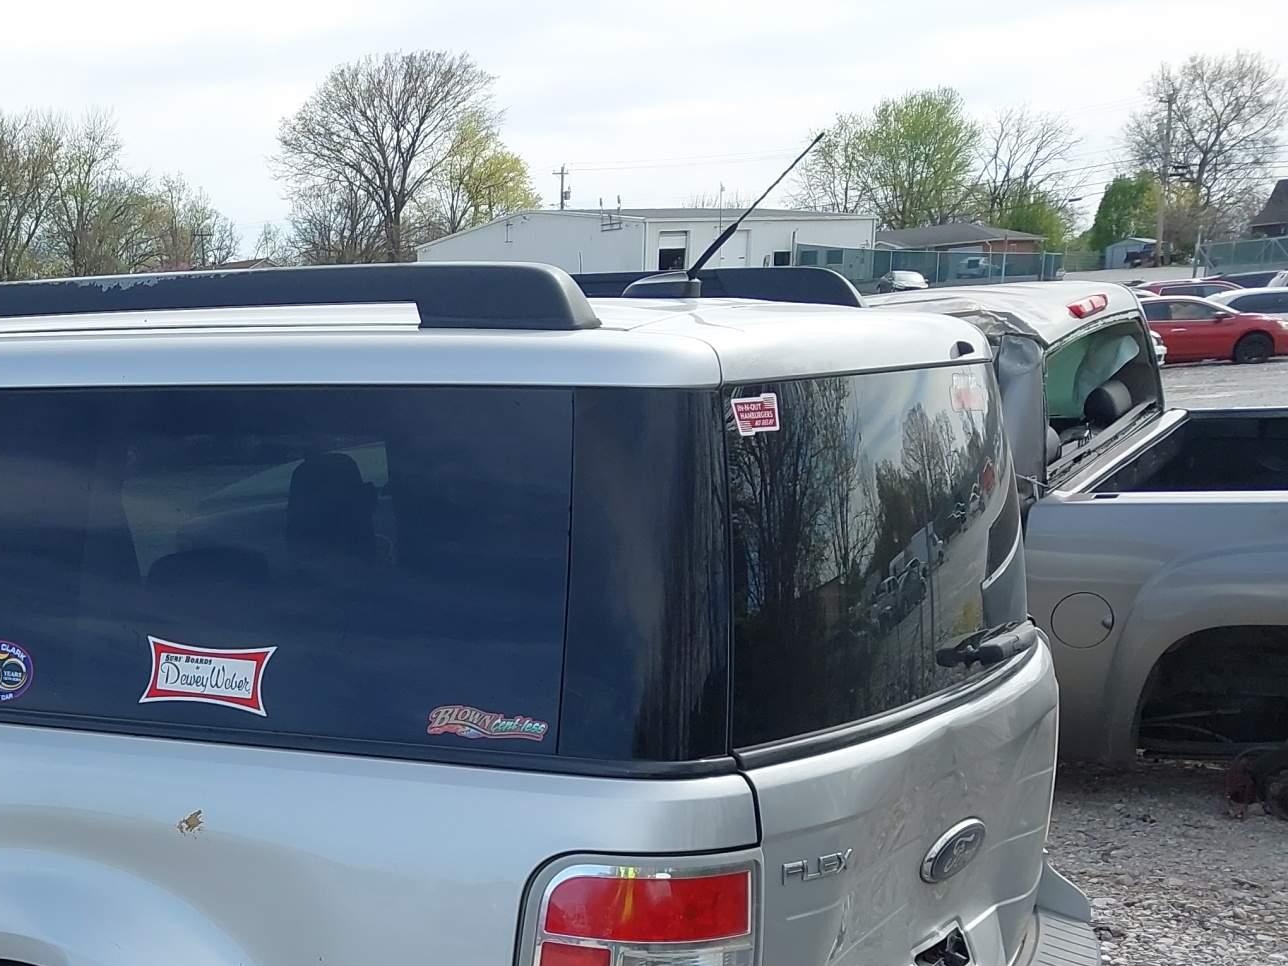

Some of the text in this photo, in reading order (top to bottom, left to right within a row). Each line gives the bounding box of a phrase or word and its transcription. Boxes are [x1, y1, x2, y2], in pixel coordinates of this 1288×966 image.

[739, 410, 774, 420] HAMBURGERS
[0, 643, 27, 661] CLARK
[160, 661, 251, 693] Dewey Weber
[434, 707, 494, 729] BLOWN
[781, 848, 853, 886] FLEX
